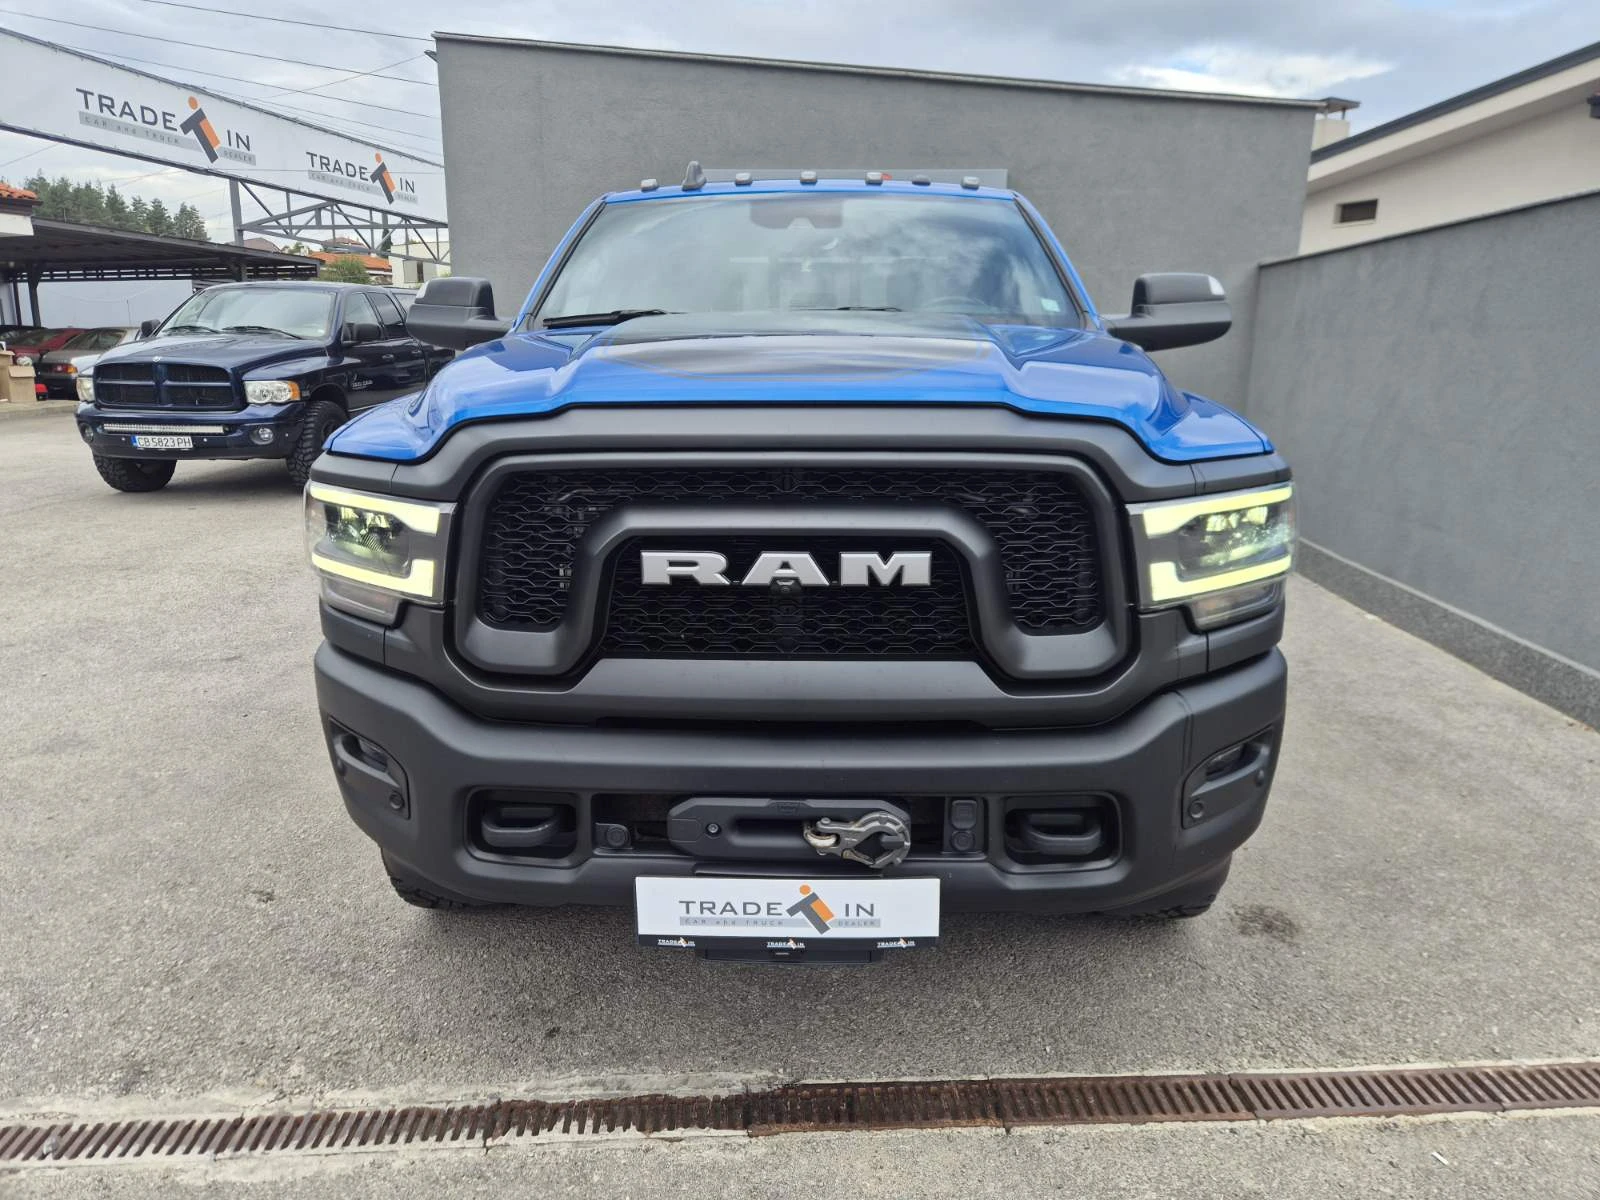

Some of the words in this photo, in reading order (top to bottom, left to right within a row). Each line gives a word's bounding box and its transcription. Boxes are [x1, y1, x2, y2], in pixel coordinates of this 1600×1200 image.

[76, 87, 178, 132] TRADE
[226, 129, 252, 152] IN
[306, 151, 369, 182] TRADE
[399, 177, 415, 194] IN
[137, 437, 150, 447] CB
[151, 437, 176, 448] 5823
[176, 437, 192, 448] PH
[641, 550, 932, 586] RAM
[679, 900, 783, 916] TRADE
[845, 903, 875, 917] IN
[746, 919, 784, 927] TRUCK
